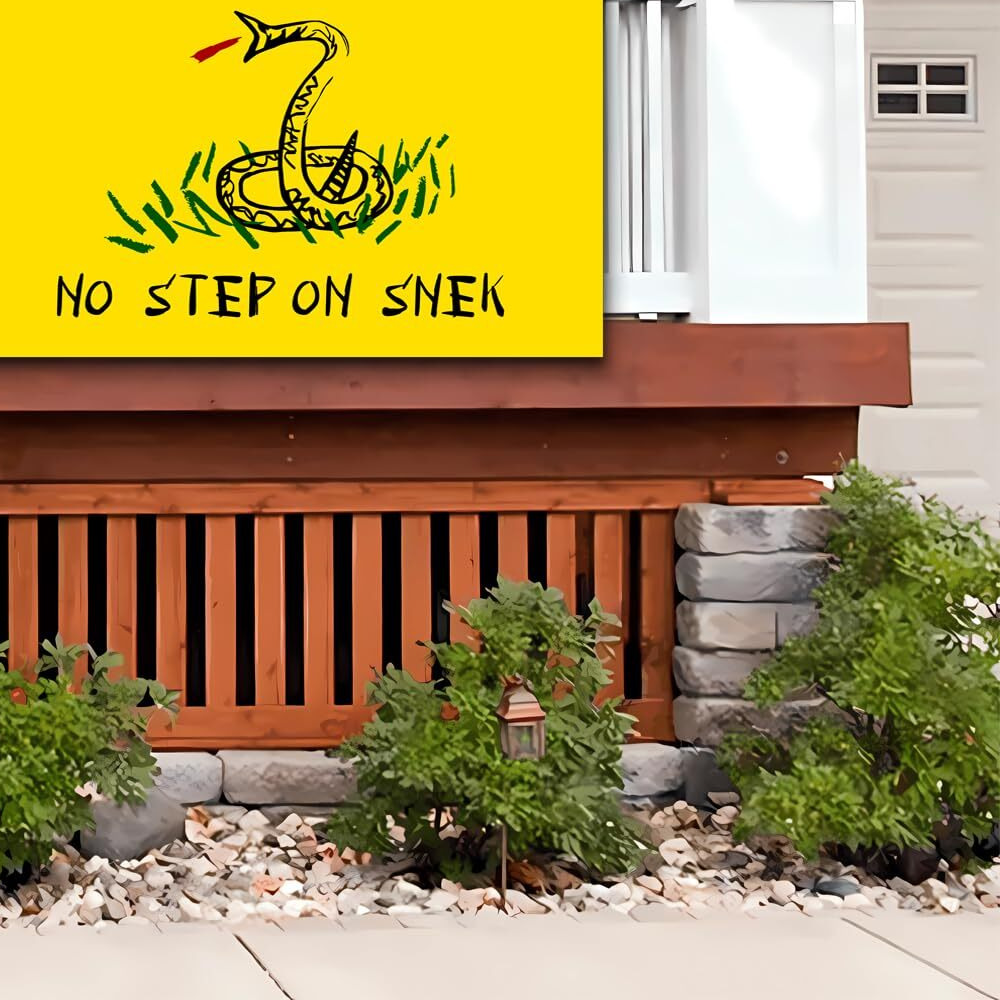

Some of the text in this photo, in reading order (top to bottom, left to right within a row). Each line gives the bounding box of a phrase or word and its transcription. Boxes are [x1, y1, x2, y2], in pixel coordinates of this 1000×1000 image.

[56, 271, 505, 318] NO STEP ON SNEK
